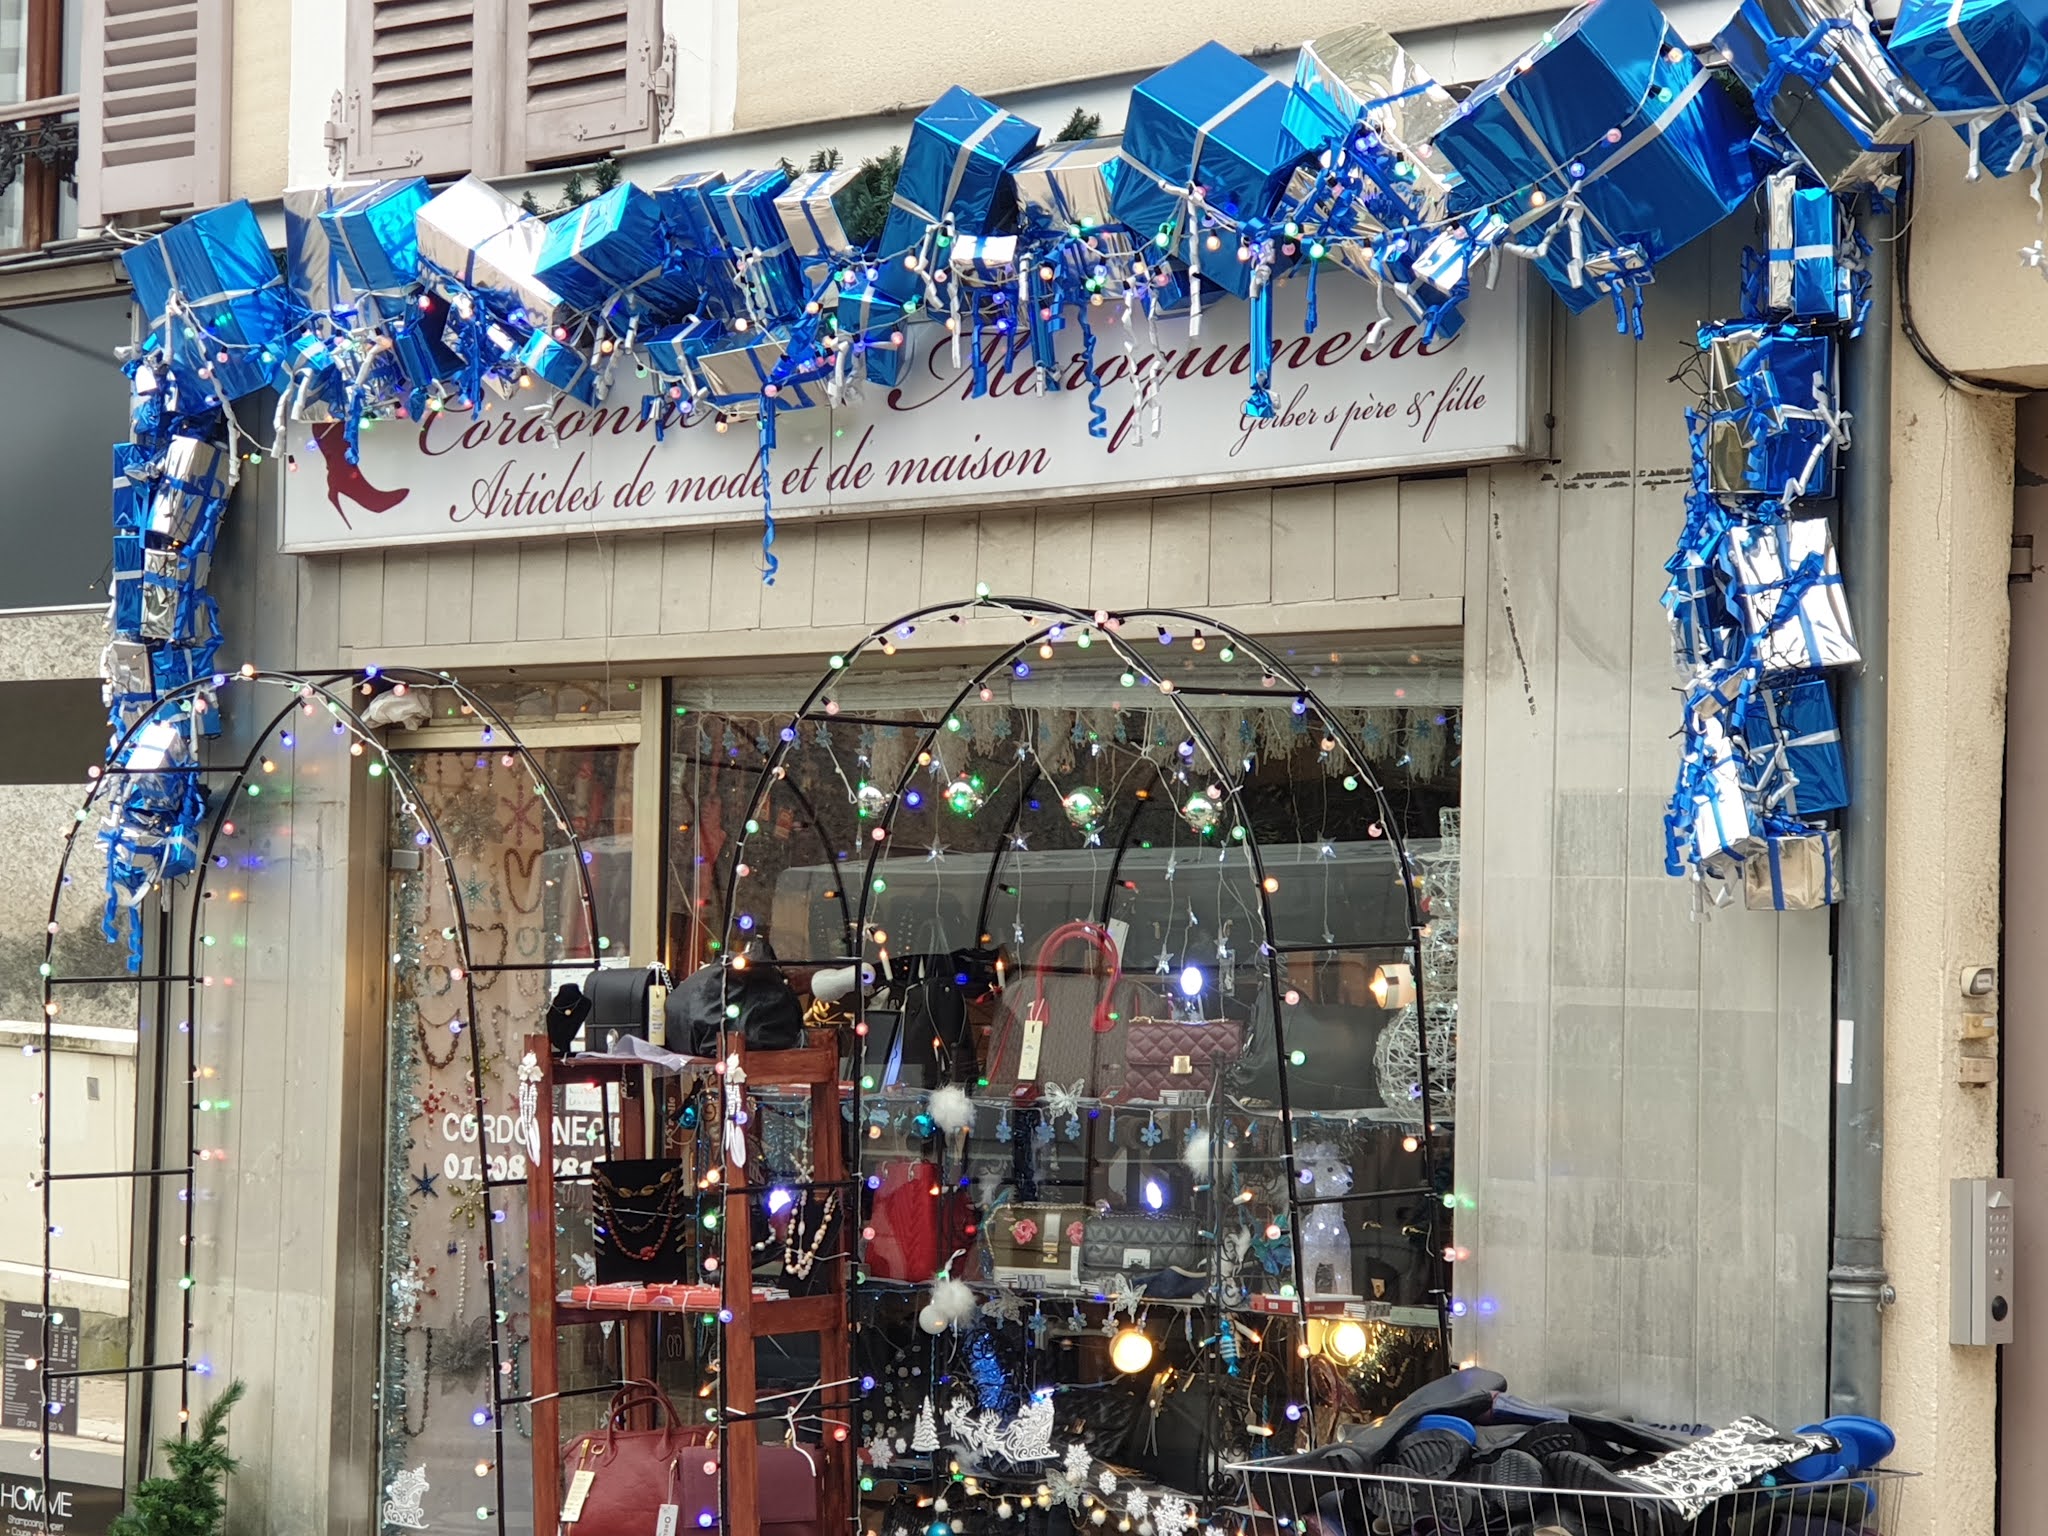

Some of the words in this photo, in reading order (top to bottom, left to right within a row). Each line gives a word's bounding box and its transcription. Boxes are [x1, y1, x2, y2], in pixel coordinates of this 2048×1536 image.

[1330, 393, 1397, 451] père
[1406, 390, 1435, 428] &
[1422, 367, 1487, 443] fille
[449, 450, 605, 522] Articles
[613, 444, 656, 509] de
[665, 449, 772, 504] mode
[781, 446, 823, 496] et
[827, 424, 876, 492] de
[885, 434, 1051, 487] maison
[1, 1483, 73, 1518] HOMME
